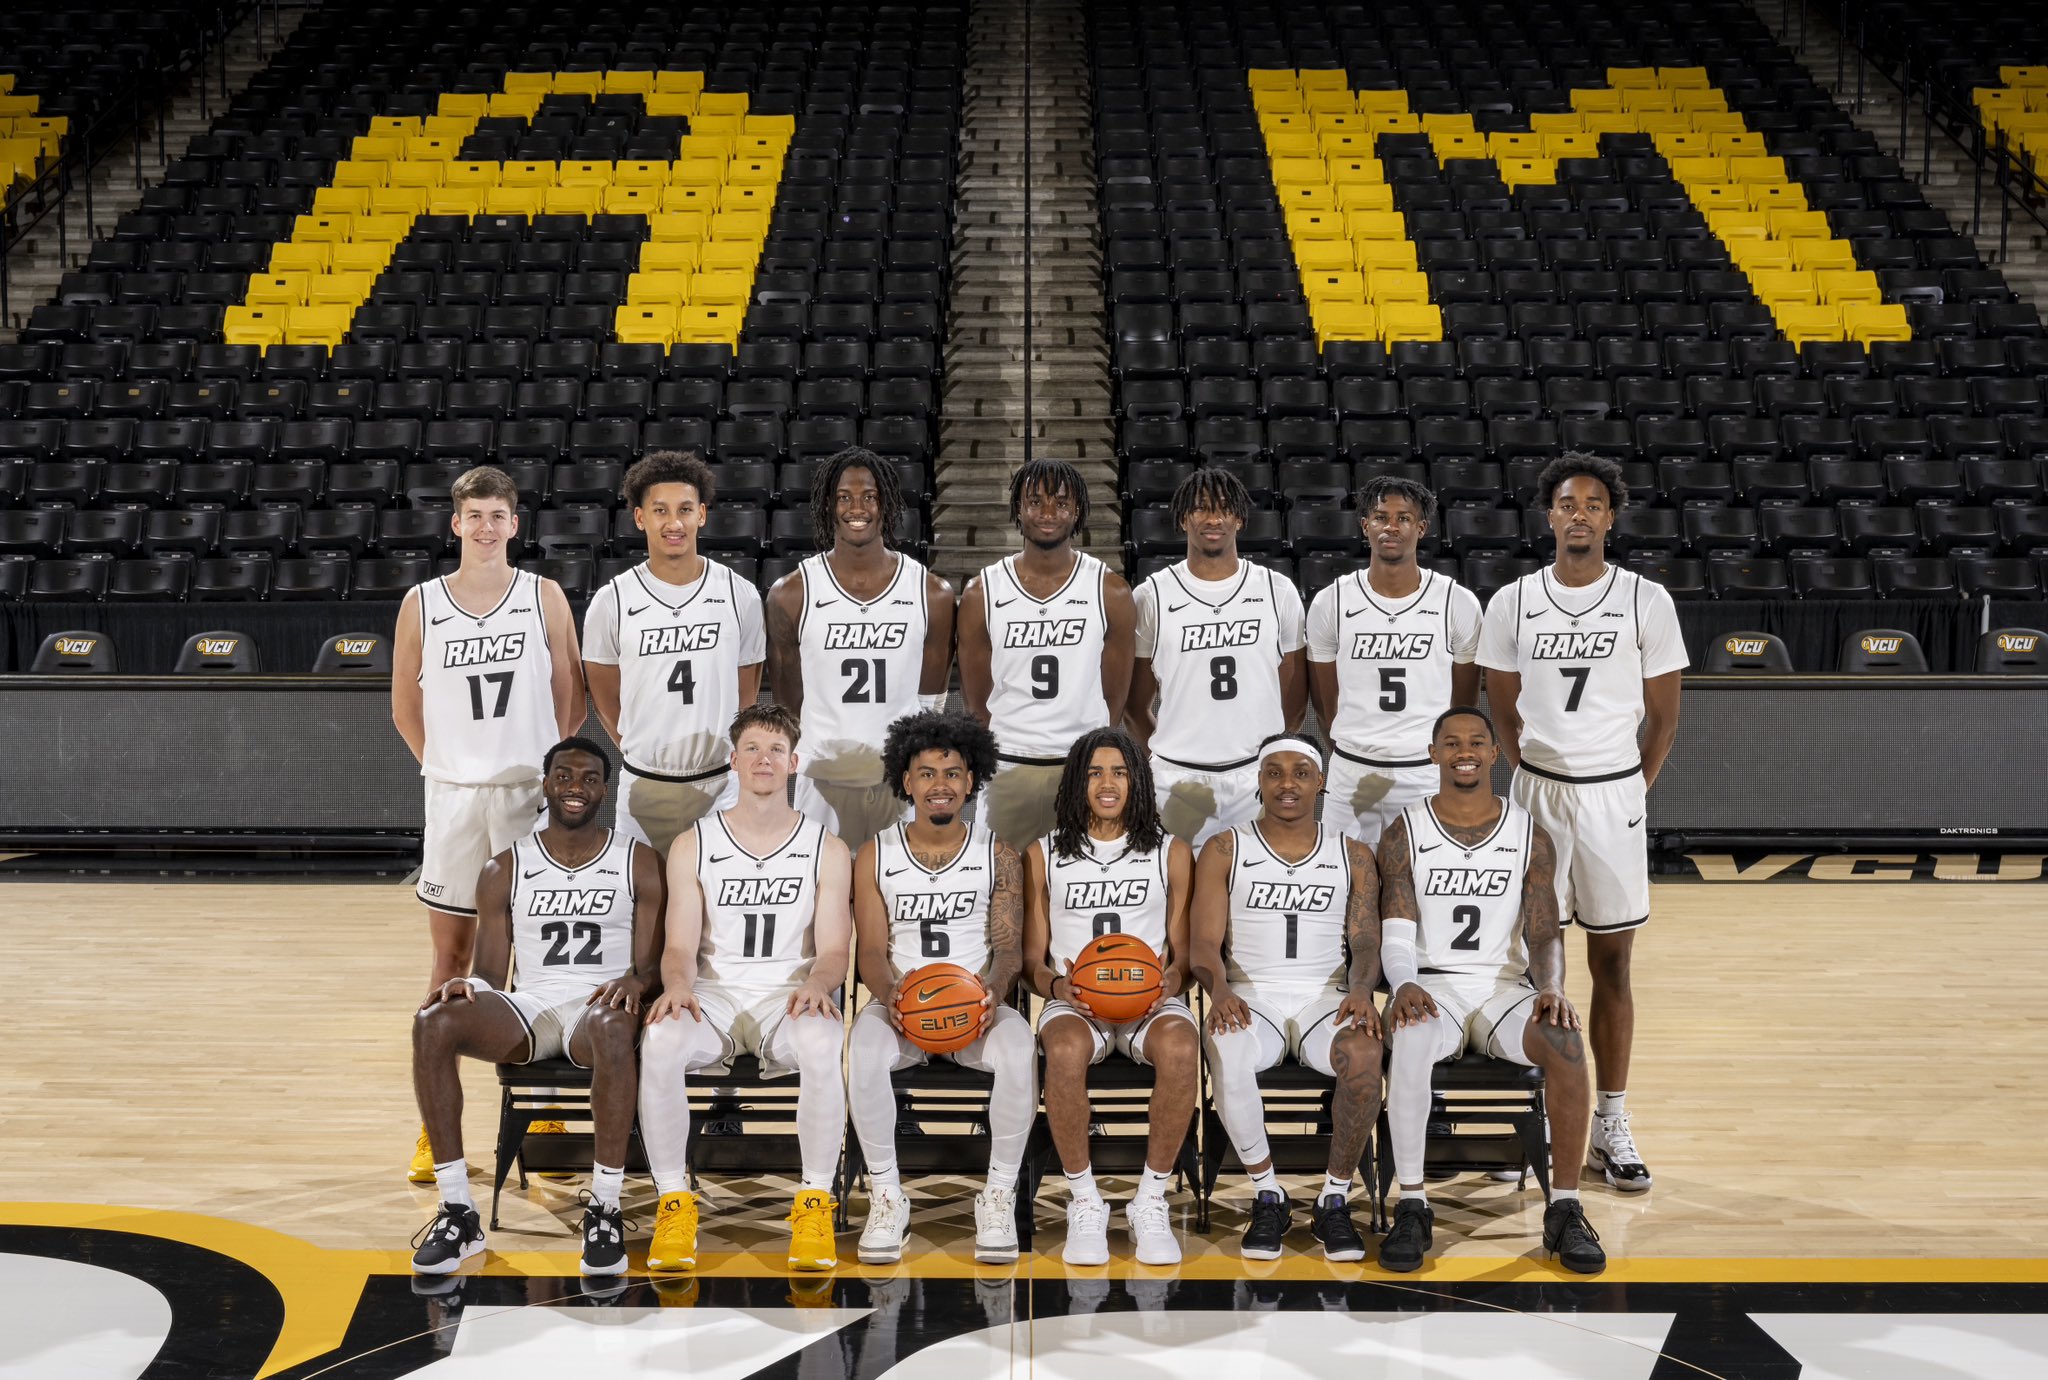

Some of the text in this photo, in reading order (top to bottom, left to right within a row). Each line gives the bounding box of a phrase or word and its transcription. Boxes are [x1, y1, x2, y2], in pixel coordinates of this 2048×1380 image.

[61, 638, 94, 653] VCU
[203, 639, 236, 653] VCU
[342, 639, 375, 653] VCU
[639, 623, 720, 656] RAMS
[824, 623, 907, 650] RAMS
[1004, 619, 1086, 648] RAMS
[1181, 619, 1260, 652] RAMS
[1351, 633, 1433, 659] RAMS
[1532, 632, 1617, 659] RAMS
[1732, 640, 1765, 655] VCU
[1867, 637, 1900, 653] VCU
[2003, 636, 2036, 651] VCU
[444, 632, 525, 668] RAMS
[668, 660, 696, 704] 4
[841, 659, 886, 703] 21
[1031, 655, 1058, 699] 9
[1210, 656, 1237, 700] 8
[1378, 668, 1406, 712] 5
[1559, 667, 1590, 711] 7
[466, 671, 514, 720] 17
[1683, 854, 2048, 881] VCU
[424, 881, 445, 897] VCU
[718, 878, 803, 906] RAMS
[1065, 879, 1149, 909] RAMS
[1246, 882, 1335, 912] RAMS
[1425, 869, 1511, 896] RAMS
[528, 889, 616, 916] RAMS
[895, 891, 977, 920] RAMS
[744, 914, 776, 957] 11
[920, 920, 950, 957] 6
[1284, 914, 1297, 958] 1
[1451, 905, 1480, 950] 2
[541, 921, 602, 966] 22
[1097, 968, 1144, 981] ELITE
[920, 1012, 969, 1031] ELITE
